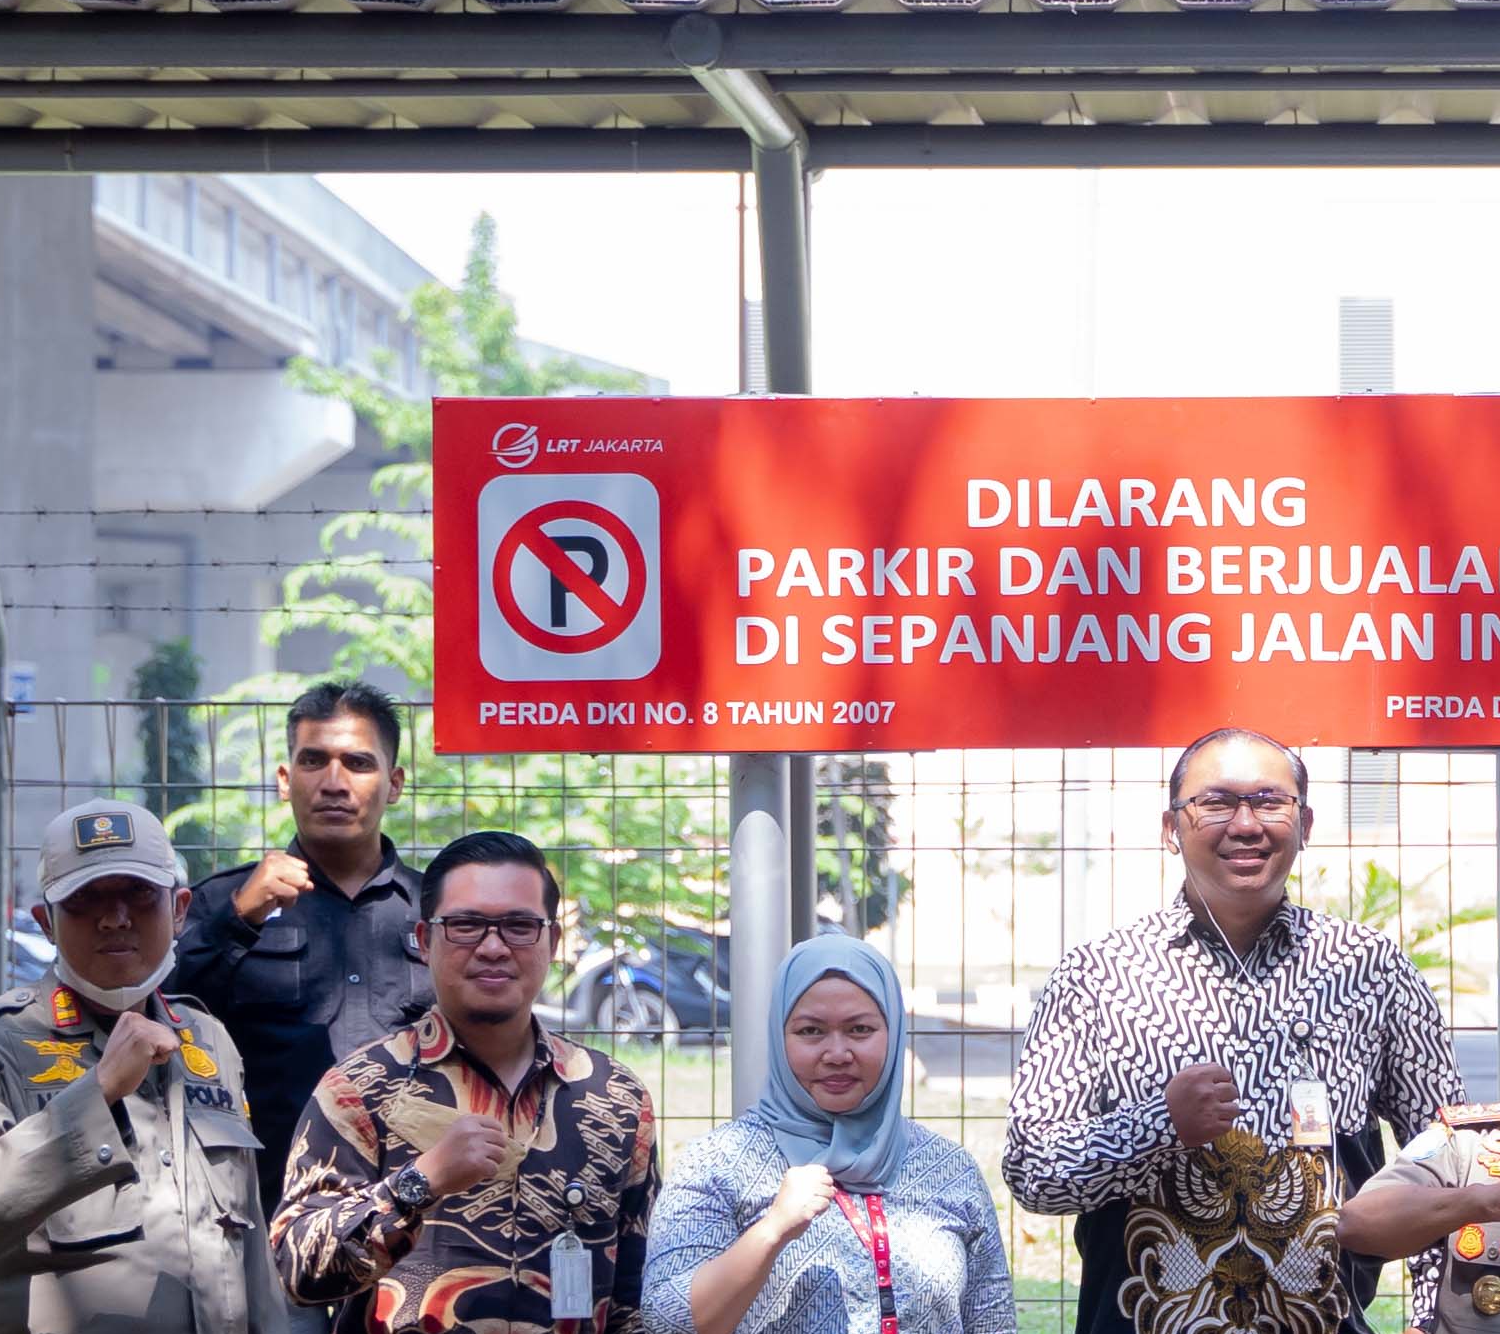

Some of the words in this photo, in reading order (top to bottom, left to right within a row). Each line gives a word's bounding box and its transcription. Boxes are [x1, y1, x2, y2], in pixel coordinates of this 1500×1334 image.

[546, 438, 580, 454] LRT
[583, 438, 664, 454] JAKARTA
[966, 476, 1307, 529] DILARANG
[737, 547, 976, 598] PARKIR
[998, 545, 1142, 597] DAN
[735, 614, 800, 666] DI
[820, 611, 1212, 665] SEPANJANG
[1230, 611, 1435, 663] JALAN
[479, 701, 581, 726] PERDA
[587, 701, 636, 726] DKI
[644, 701, 695, 726] NO.
[702, 700, 720, 726] 8
[725, 700, 825, 726] TAHUN
[832, 700, 897, 725] 2007
[1385, 695, 1486, 719] PERDA
